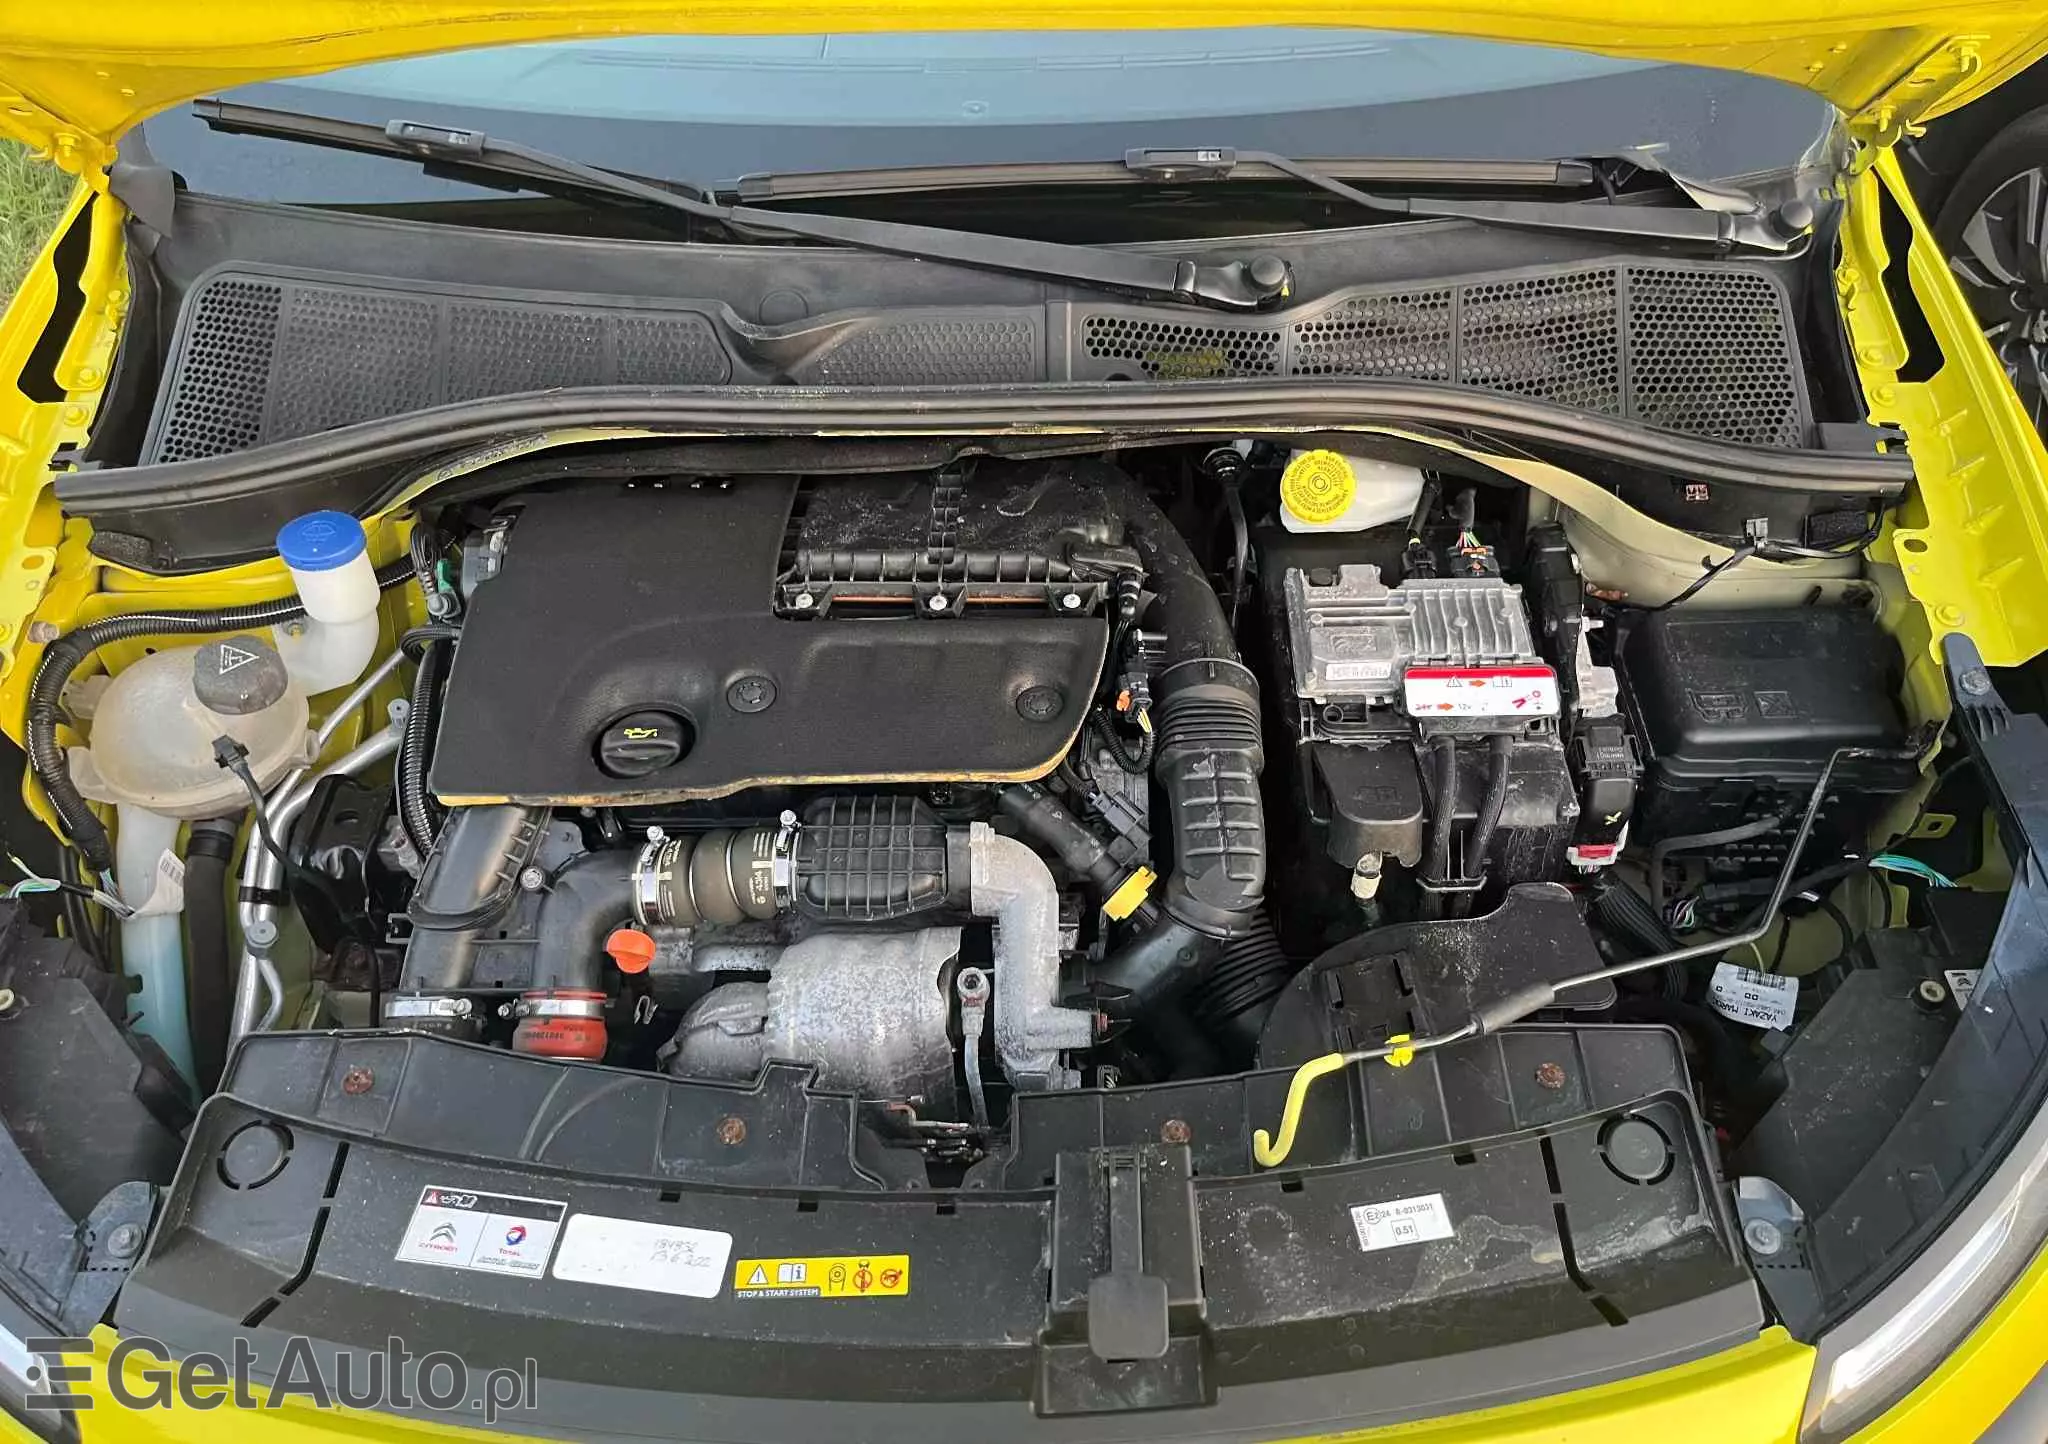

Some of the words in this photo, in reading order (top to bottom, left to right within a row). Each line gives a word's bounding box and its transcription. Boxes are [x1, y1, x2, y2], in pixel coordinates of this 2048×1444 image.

[1743, 1007, 1778, 1022] YAZAKI
[737, 1290, 758, 1299] STOP
[765, 1289, 789, 1298] START
[789, 1288, 819, 1297] SYSTEM
